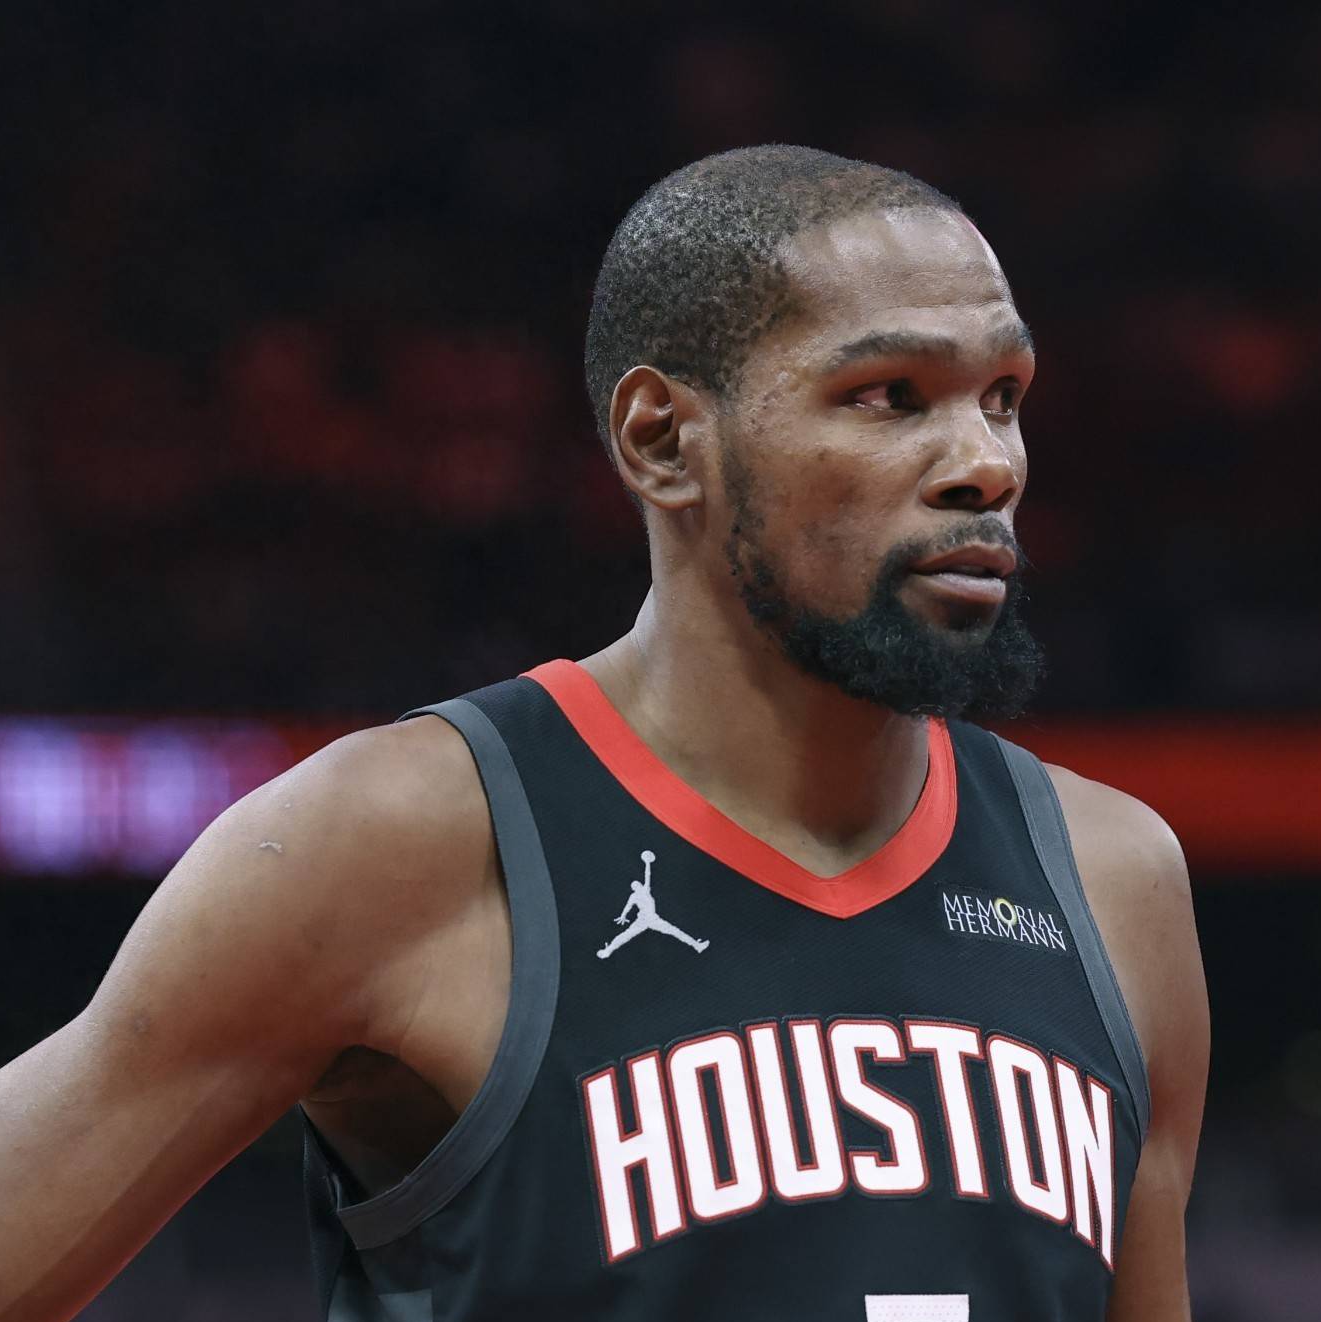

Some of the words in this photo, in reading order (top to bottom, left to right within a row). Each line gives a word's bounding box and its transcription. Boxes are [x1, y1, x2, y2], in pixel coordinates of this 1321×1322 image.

[942, 891, 1063, 935] MEMORIAL
[945, 910, 1067, 951] HERMANN
[582, 1018, 1115, 1272] HOUSTON
